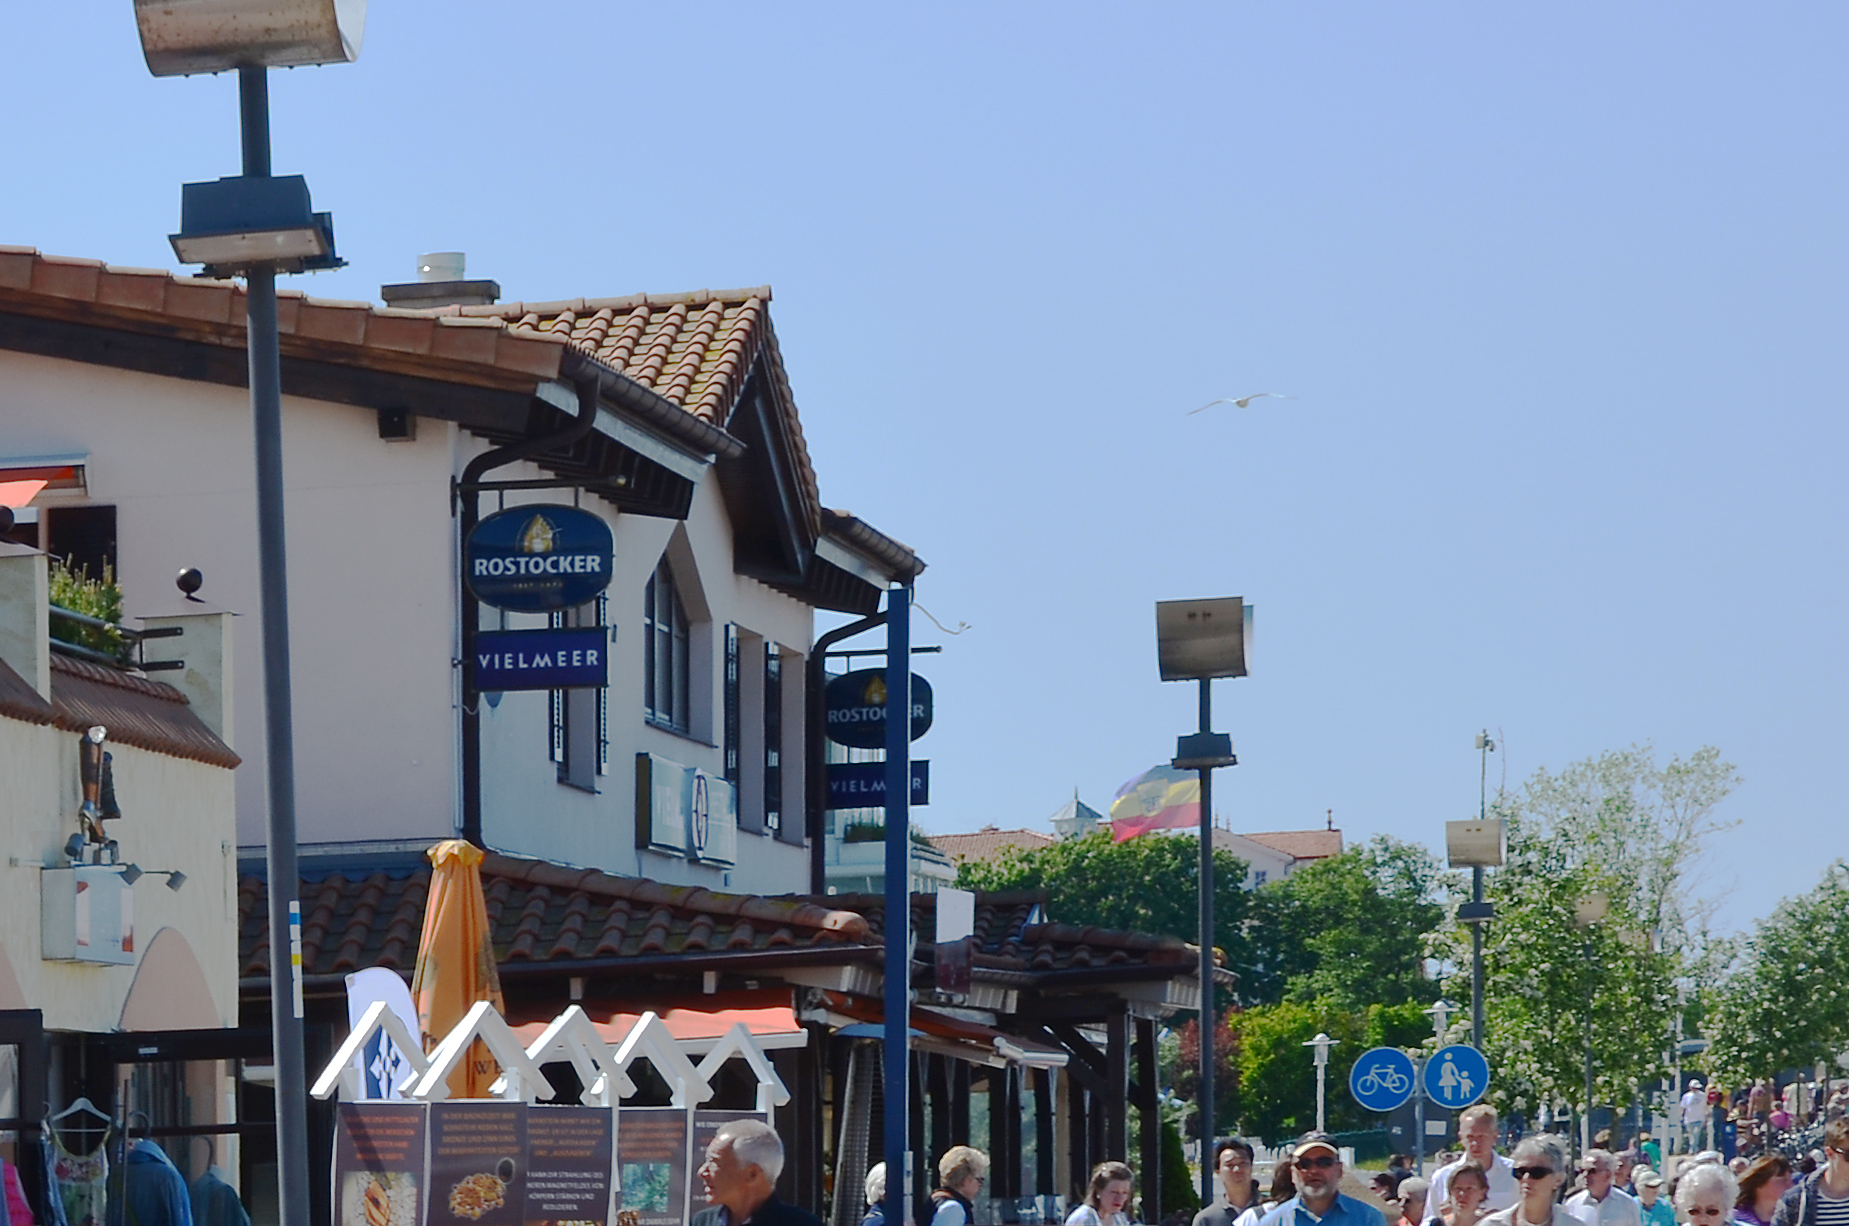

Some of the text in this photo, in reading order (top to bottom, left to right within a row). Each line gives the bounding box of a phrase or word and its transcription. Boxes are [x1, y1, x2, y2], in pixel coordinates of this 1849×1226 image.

[474, 555, 601, 576] ROSTOCKER
[478, 649, 598, 669] VIELMEER
[827, 704, 925, 723] ROSTOR
[830, 777, 922, 793] VIELMR
